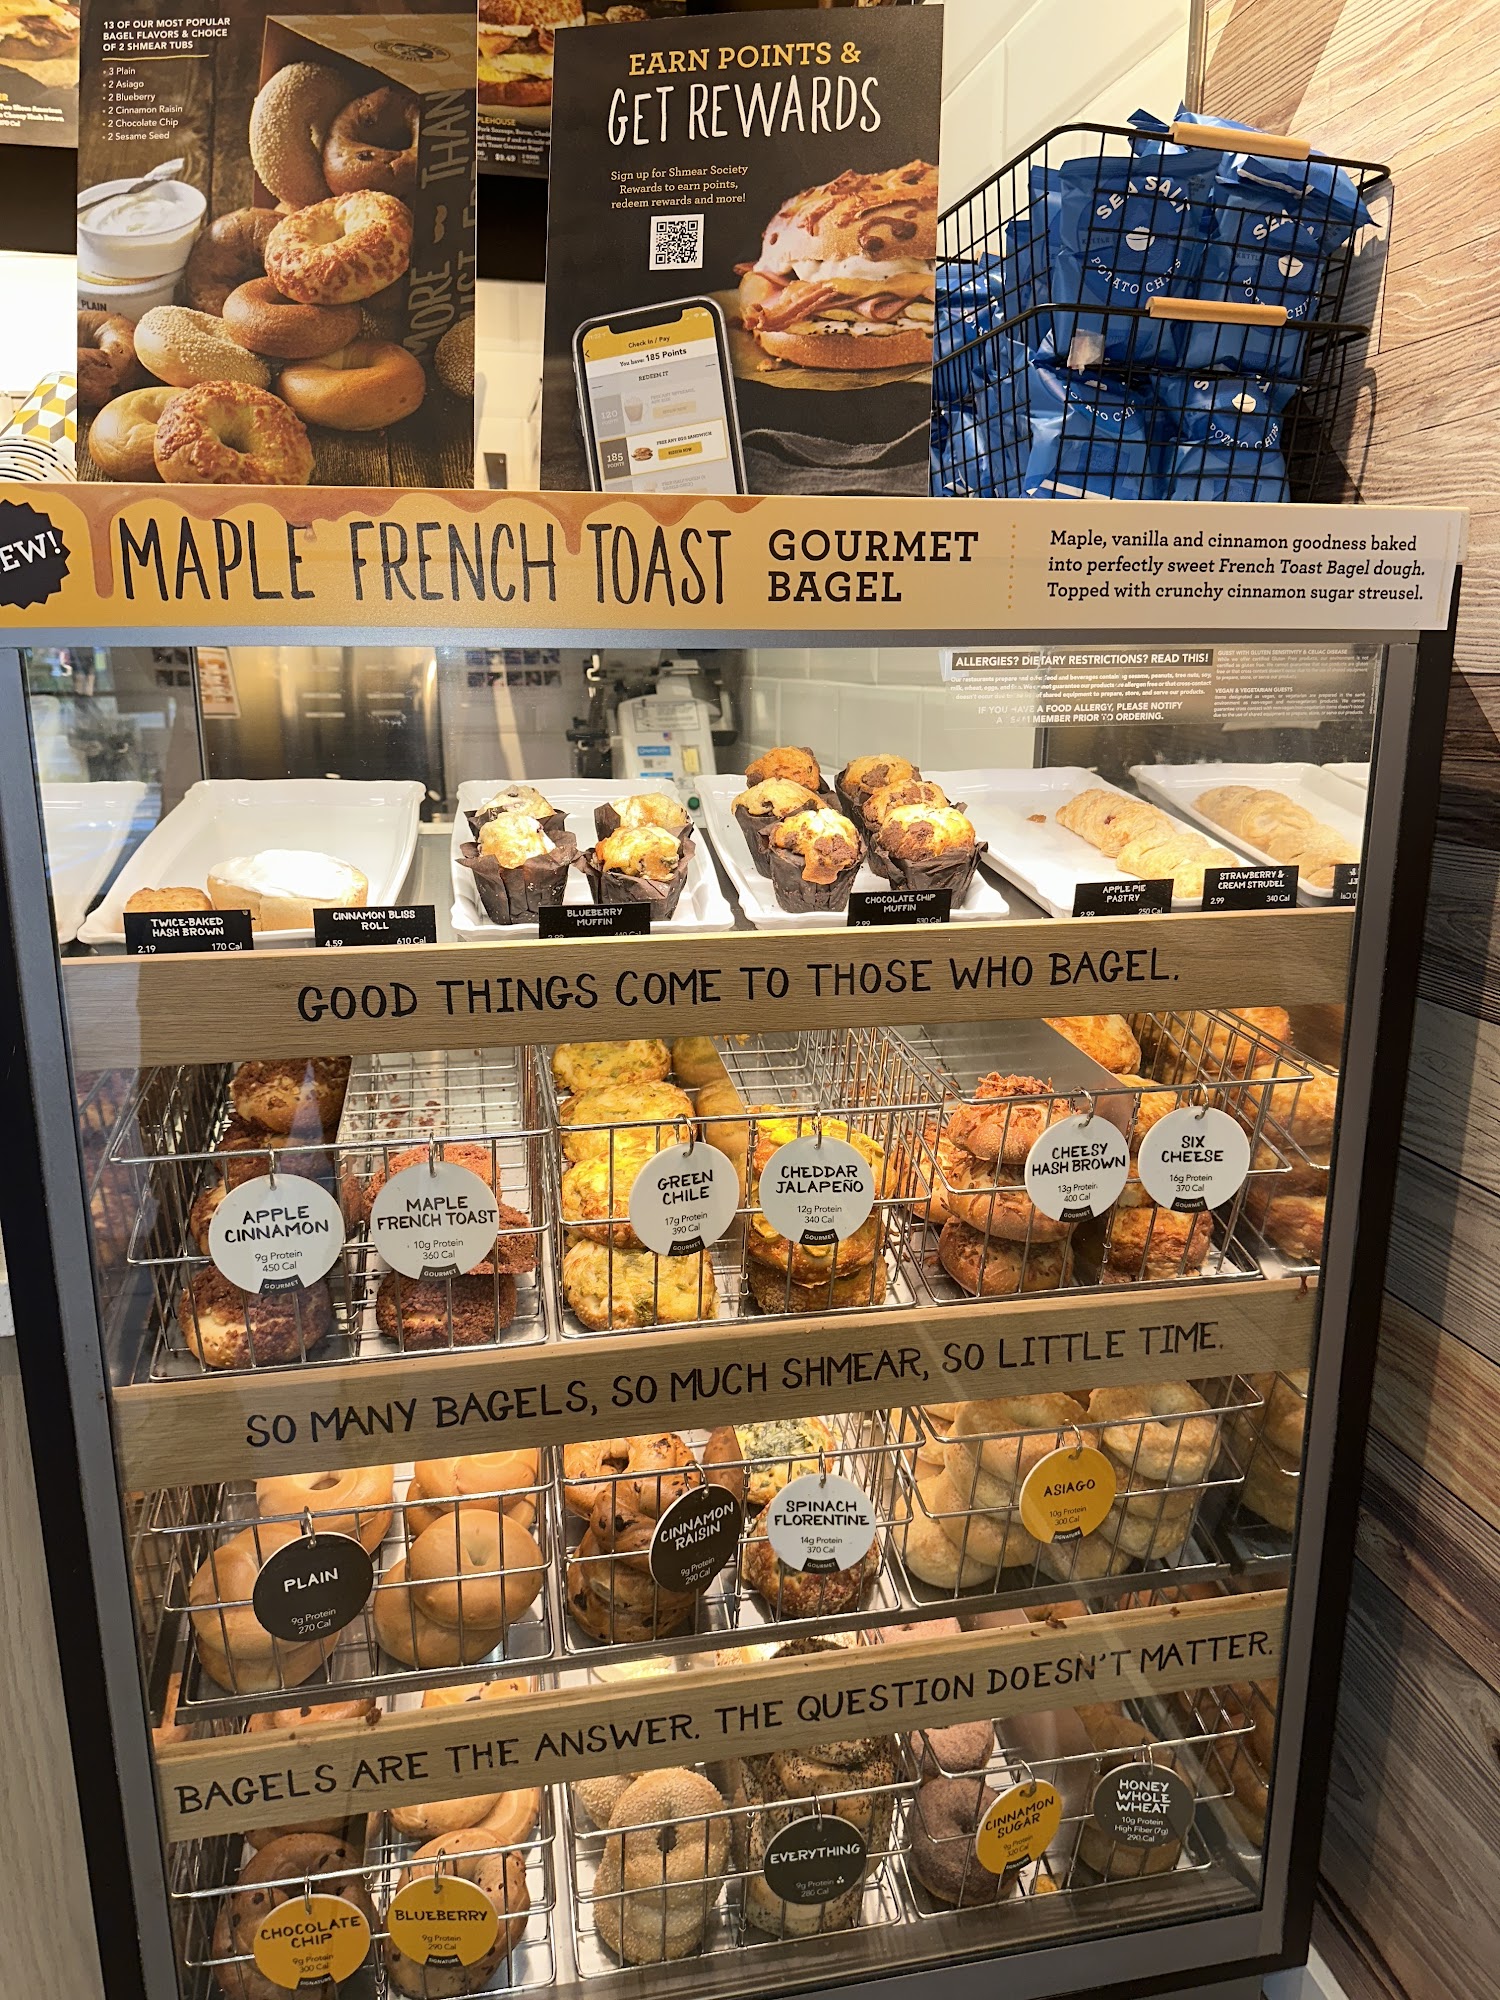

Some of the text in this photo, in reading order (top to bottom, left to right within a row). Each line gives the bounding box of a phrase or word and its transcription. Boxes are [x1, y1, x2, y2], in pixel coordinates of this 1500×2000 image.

[103, 17, 231, 29] 13 OF OUR MOST POPULAR
[103, 29, 228, 40] BAGEL FLAVORS & CHOICE
[103, 41, 193, 51] OF 2 SHMEAR TUBS
[629, 41, 862, 76] EARN POINTS &
[116, 67, 135, 75] Plain
[116, 93, 156, 102] Blueberry
[116, 106, 157, 114] Cinnamon
[159, 105, 183, 113] Raisin
[608, 75, 881, 146] GET REWARDS
[115, 119, 157, 127] Chocolate
[159, 118, 179, 128] Chip
[115, 132, 147, 140] Sesame
[149, 131, 170, 140] Seed
[611, 164, 748, 183] Sign up for Shmear Society
[620, 180, 738, 195] Rewards to earn points,
[611, 193, 746, 209] redeem rewards and more!
[1097, 181, 1138, 220] SEA
[646, 353, 660, 362] 185
[662, 348, 687, 359] Points
[768, 529, 979, 562] GOURMET
[1050, 529, 1417, 553] Maple, vanilla and cinnamon goodness baked
[0, 531, 62, 573] EW!
[119, 516, 732, 607] MAPLE FRENCH TOAST
[1048, 556, 1425, 582] into perfectly sweet French Toast Bagel dough.
[767, 571, 903, 603] BAGEL
[1047, 581, 1424, 602] Topped with crunchy cinnamon sugar streusel.
[955, 655, 1019, 667] ALLERGIES?
[1022, 654, 1066, 667] DIETARY
[1068, 654, 1149, 666] RESTRICTIONS?
[1151, 653, 1180, 665] READ
[1182, 652, 1209, 664] THIS!
[1219, 870, 1285, 880] STRAWBERRY &
[1218, 879, 1285, 891] CREAM STRUDEL
[1210, 894, 1290, 905] 2.99 340 Cal
[150, 916, 224, 928] TWICE-BAKED
[152, 926, 225, 938] HASH BROWN
[137, 941, 243, 954] 2.19 170 Cal
[298, 947, 1179, 1022] GOOD THINGS COME TO THOSE WHO BAGEL.
[1181, 1135, 1206, 1149] SIX
[1052, 1143, 1108, 1160] CHEESY
[1161, 1150, 1224, 1163] CHEESE
[781, 1165, 858, 1178] CHEDDAR
[1032, 1155, 1126, 1177] HASH BROWN
[657, 1169, 713, 1191] GREEN
[775, 1178, 864, 1194] JALAPEÑO
[406, 1195, 468, 1212] MAPLE
[662, 1186, 710, 1206] CHILE
[242, 1205, 310, 1225] APPLE
[797, 1204, 842, 1215] 12g Protein
[377, 1210, 498, 1230] FRENCH TOAST
[804, 1215, 834, 1224] 340 Cal
[224, 1219, 329, 1243] CINNAMON
[247, 1321, 1224, 1448] SO MANY BAGELS, SO MUCH SHMEAR, SO LITTLE TIME.
[1043, 1479, 1096, 1497] ASIAGO
[786, 1500, 857, 1513] SPINACH
[660, 1502, 735, 1544] CINNAMON
[774, 1514, 870, 1527] FLORENTINE
[675, 1520, 721, 1551] RAISIN
[283, 1567, 339, 1593] PLAIN
[174, 1629, 1274, 1815] BAGELS ARE THE ANSWER. THE QUESTION DOESN'T MATTER.
[1119, 1779, 1169, 1792] HONEY
[1117, 1791, 1171, 1804] WHOLE
[985, 1796, 1055, 1831] CINNAMON
[1115, 1801, 1170, 1814] WHEAT
[997, 1813, 1041, 1839] SUGAR
[770, 1843, 861, 1865] EVERYTHING
[395, 1910, 488, 1922] BLUEBERRY
[260, 1916, 361, 1941] CHOCOLATE
[291, 1933, 333, 1949] CHIP
